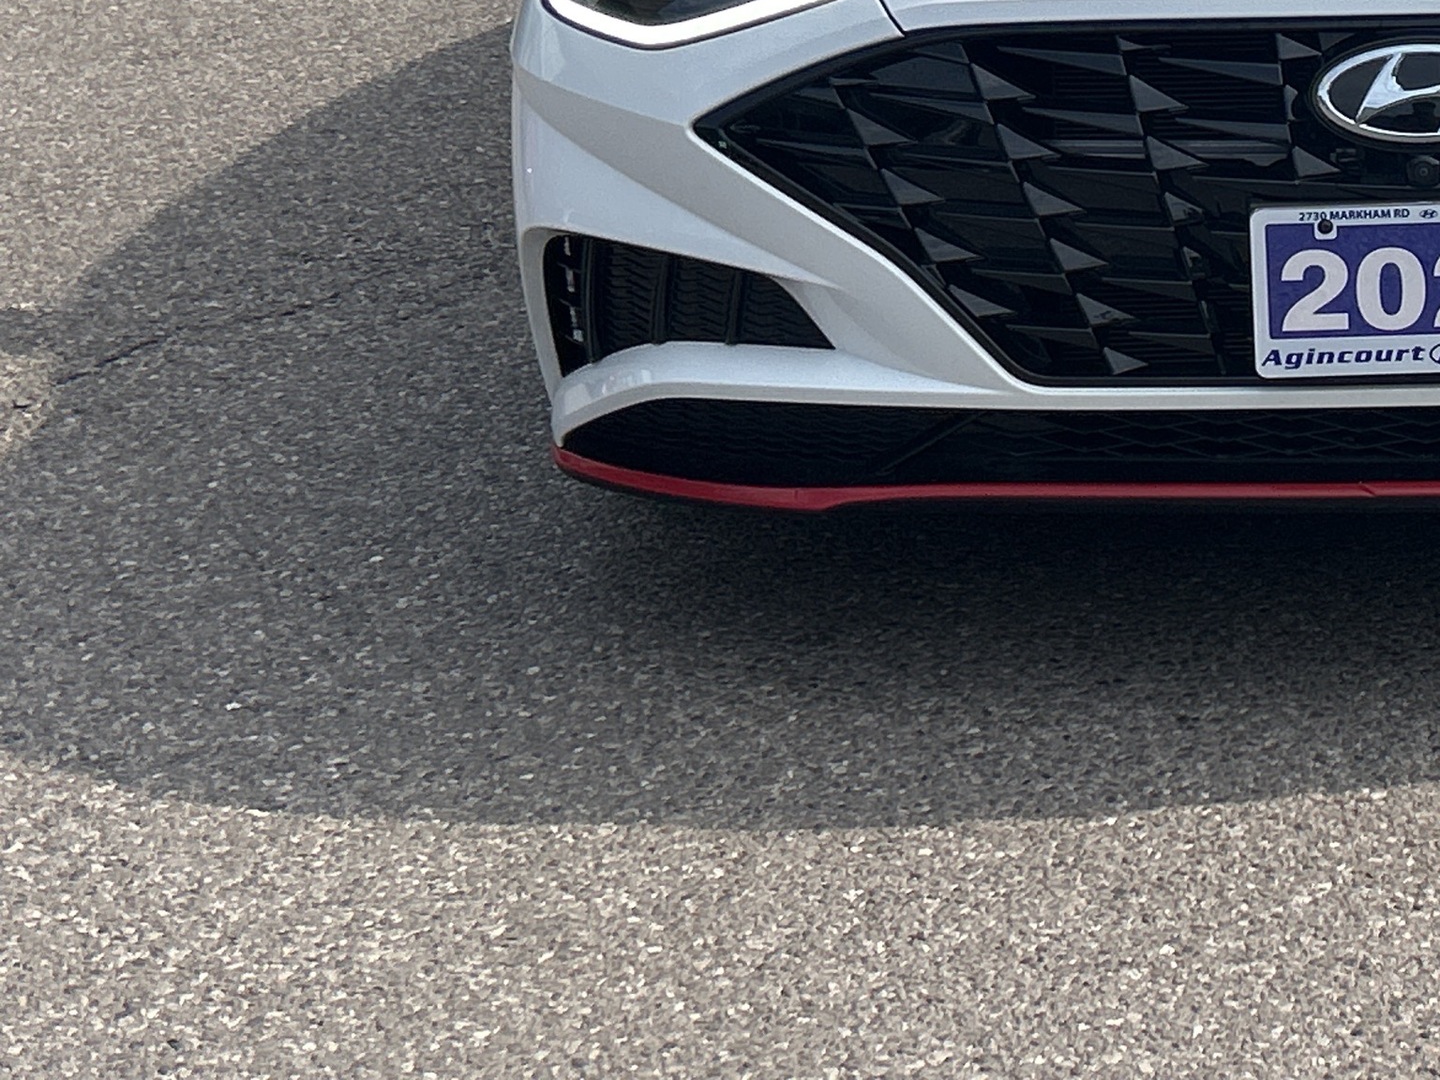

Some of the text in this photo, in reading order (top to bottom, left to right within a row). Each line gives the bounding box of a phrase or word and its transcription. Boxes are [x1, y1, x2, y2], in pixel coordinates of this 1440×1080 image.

[1299, 211, 1327, 222] 2730
[1330, 209, 1391, 220] MARKHAM
[1393, 208, 1410, 218] RD
[1262, 345, 1426, 370] Agincourt
